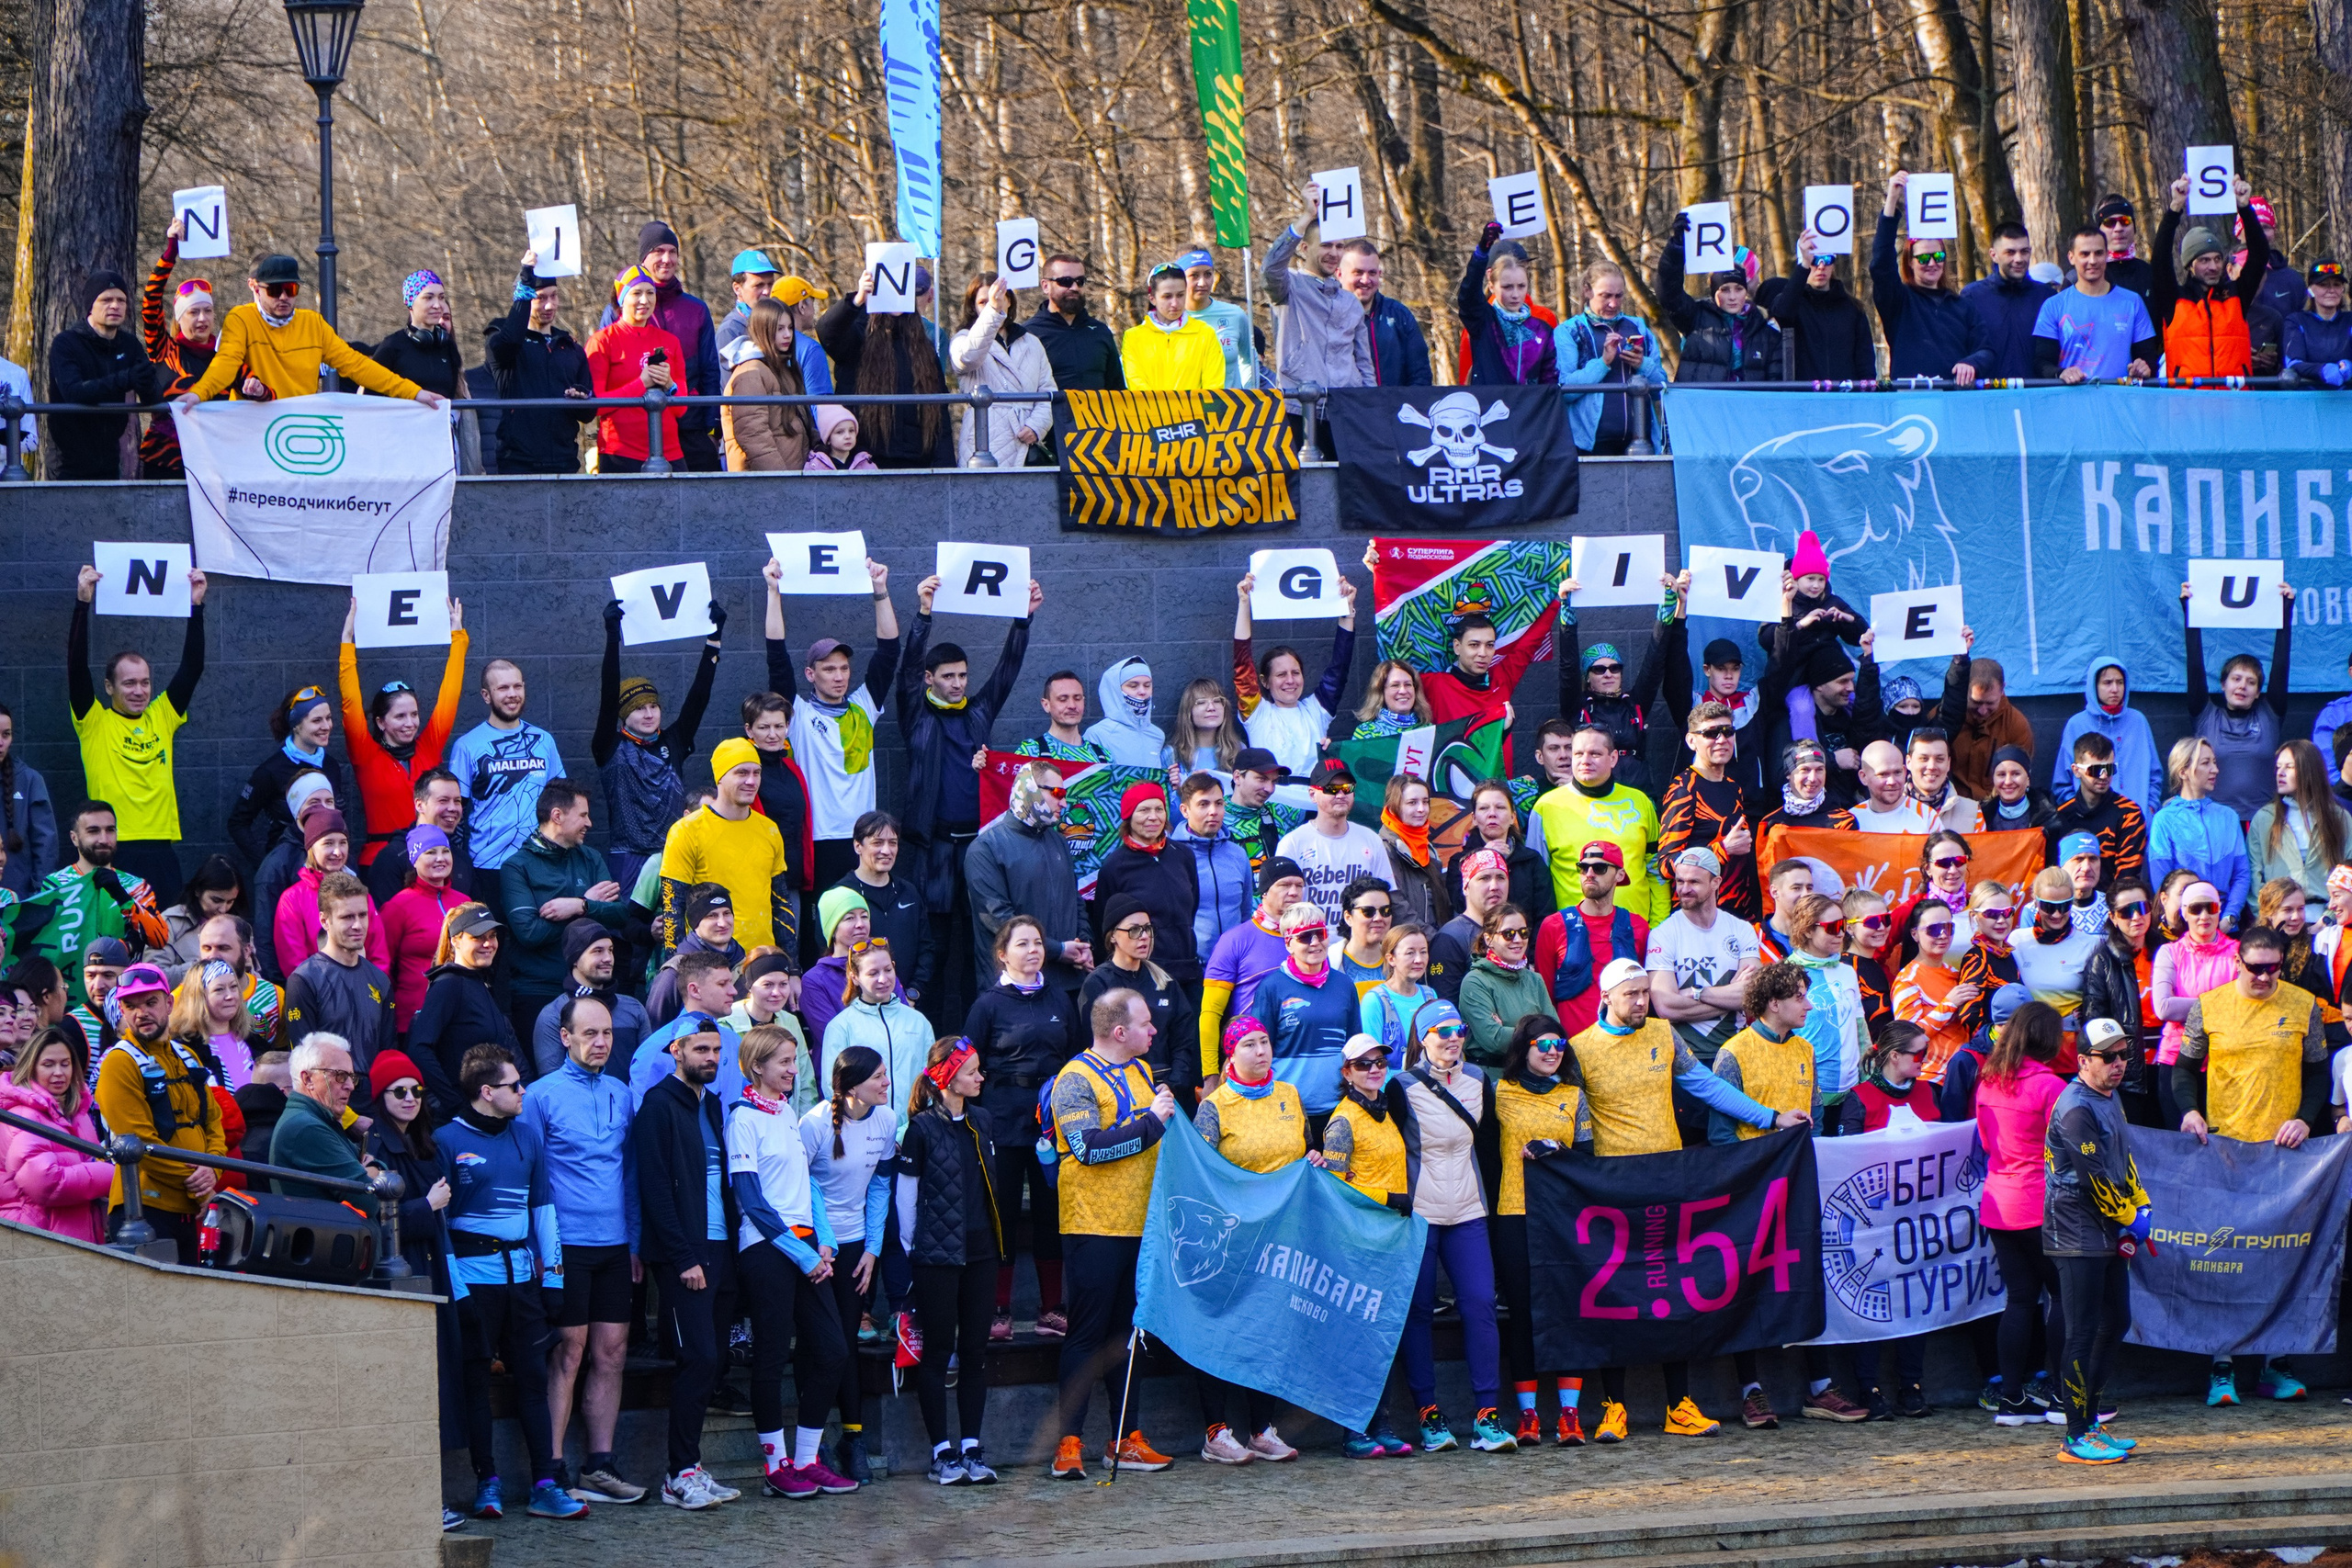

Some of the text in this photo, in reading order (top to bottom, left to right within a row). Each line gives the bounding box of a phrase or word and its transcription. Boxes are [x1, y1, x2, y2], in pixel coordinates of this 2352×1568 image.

[2199, 164, 2228, 198] S
[1322, 184, 1352, 222] H
[1507, 189, 1537, 227] E
[1814, 204, 1850, 238] O
[1919, 191, 1949, 223] E
[183, 204, 220, 243] N
[1696, 221, 1725, 257] R
[553, 226, 561, 261] I
[1005, 238, 1035, 273] G
[871, 261, 911, 298] N
[1064, 389, 1218, 433] RUNNING
[1156, 423, 1197, 442] RHR
[1119, 430, 1247, 477] HEROES
[1407, 479, 1524, 503] ULTRAS
[1429, 464, 1502, 485] RHR
[228, 488, 392, 514] #переводчикибегут
[1169, 472, 1296, 529] RUSSIA
[2081, 460, 2352, 558] КАПИБ
[808, 544, 840, 575] E
[1407, 547, 1454, 556] СУПЕРЛИГА
[1611, 552, 1631, 587] I
[124, 558, 168, 596] N
[963, 559, 1009, 597] R
[1278, 565, 1322, 600] G
[1724, 564, 1761, 600] V
[2220, 575, 2260, 609] U
[387, 589, 422, 626] E
[650, 581, 687, 621] V
[1904, 604, 1938, 640] E
[488, 759, 545, 773] MALIDAK
[59, 883, 84, 953] RUN
[1894, 1149, 1957, 1207] БЕГ
[1575, 1176, 1801, 1320] 2.54
[1644, 1204, 1668, 1288] RUNNING
[2233, 1232, 2312, 1249] ГРУППА
[1254, 1243, 1384, 1323] КАПИБАРА
[2189, 1259, 2244, 1274] КАПИБАРА
[1896, 1255, 2006, 1318] ТУРИЗ
[1289, 1293, 1329, 1323] КУСКОВО
